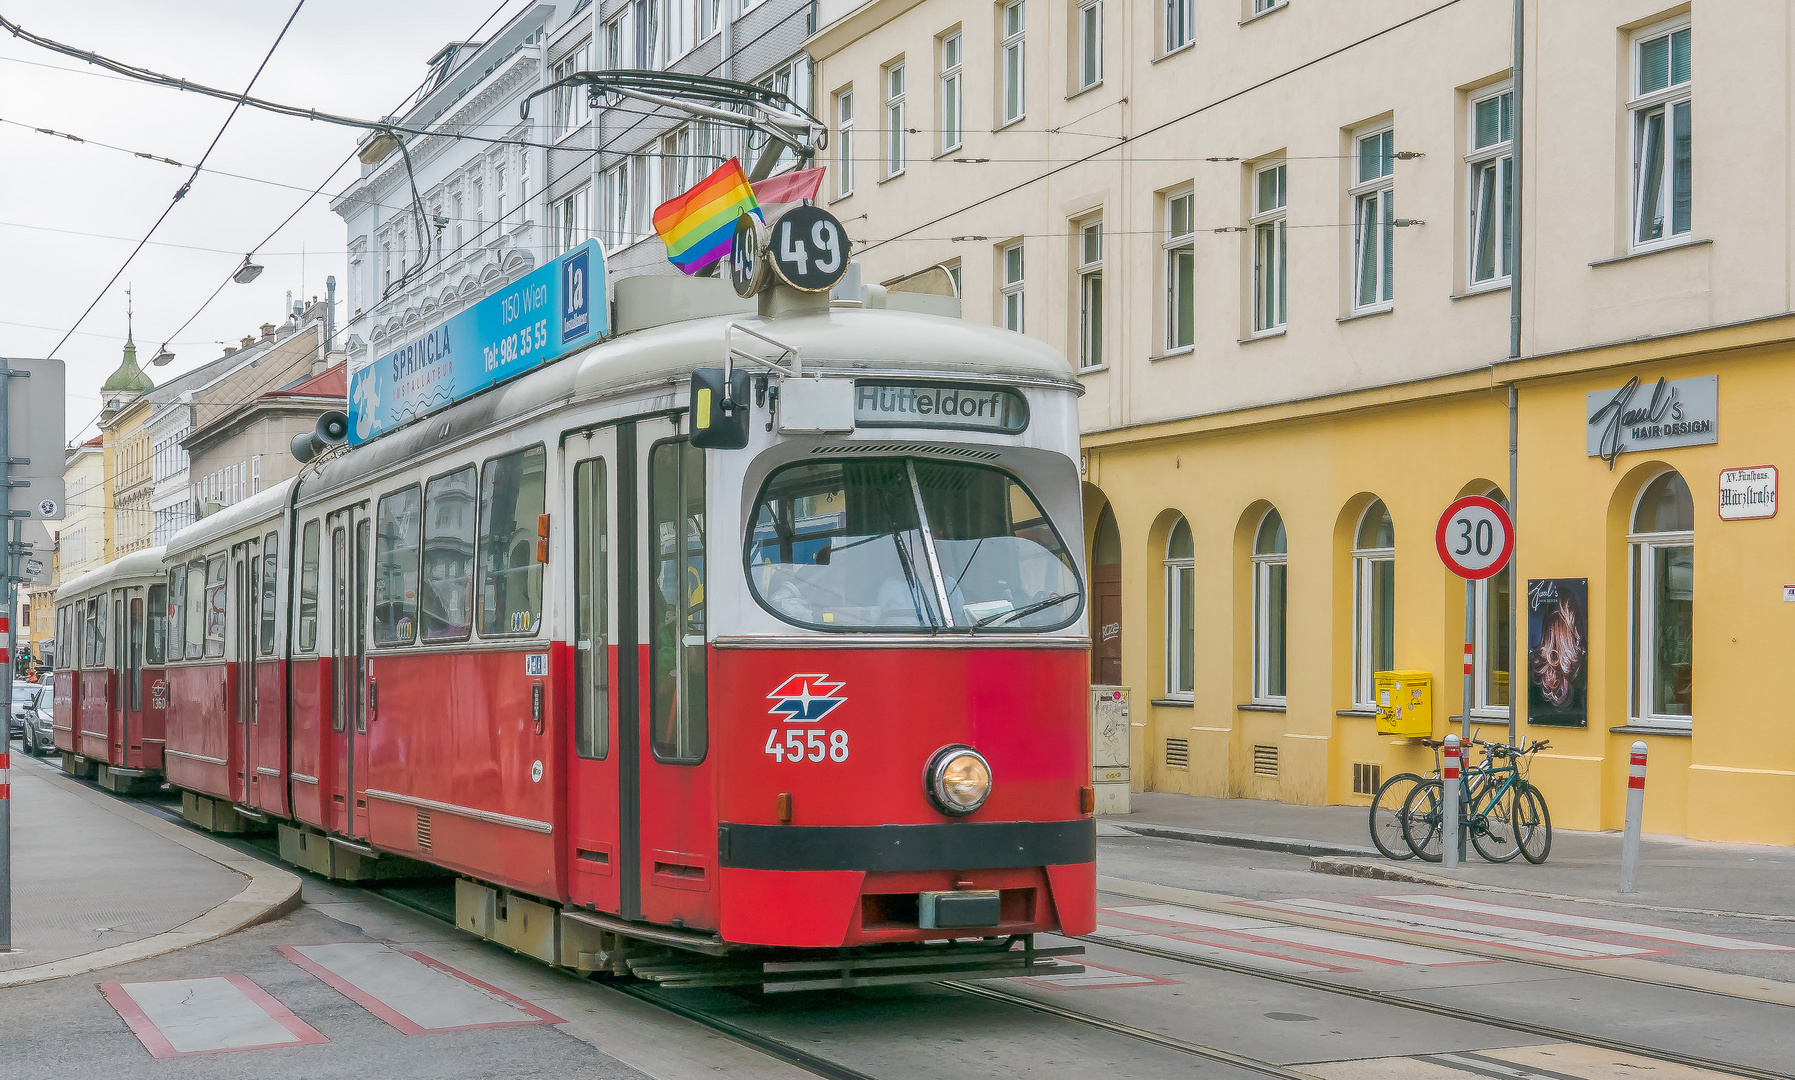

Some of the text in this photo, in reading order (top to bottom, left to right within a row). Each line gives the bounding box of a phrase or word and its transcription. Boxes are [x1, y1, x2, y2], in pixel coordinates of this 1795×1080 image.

[734, 226, 754, 284] 49
[780, 219, 841, 275] 49
[501, 283, 547, 325] 1150 Wien
[567, 262, 584, 314] 1a
[483, 319, 547, 372] Tel: 982 35 55
[392, 360, 453, 401] INSTALLATEUR
[857, 386, 1000, 418] Hütteldorf
[1631, 419, 1711, 440] HAIR DESIGN
[1455, 518, 1493, 556] 30
[764, 728, 850, 764] 4558
